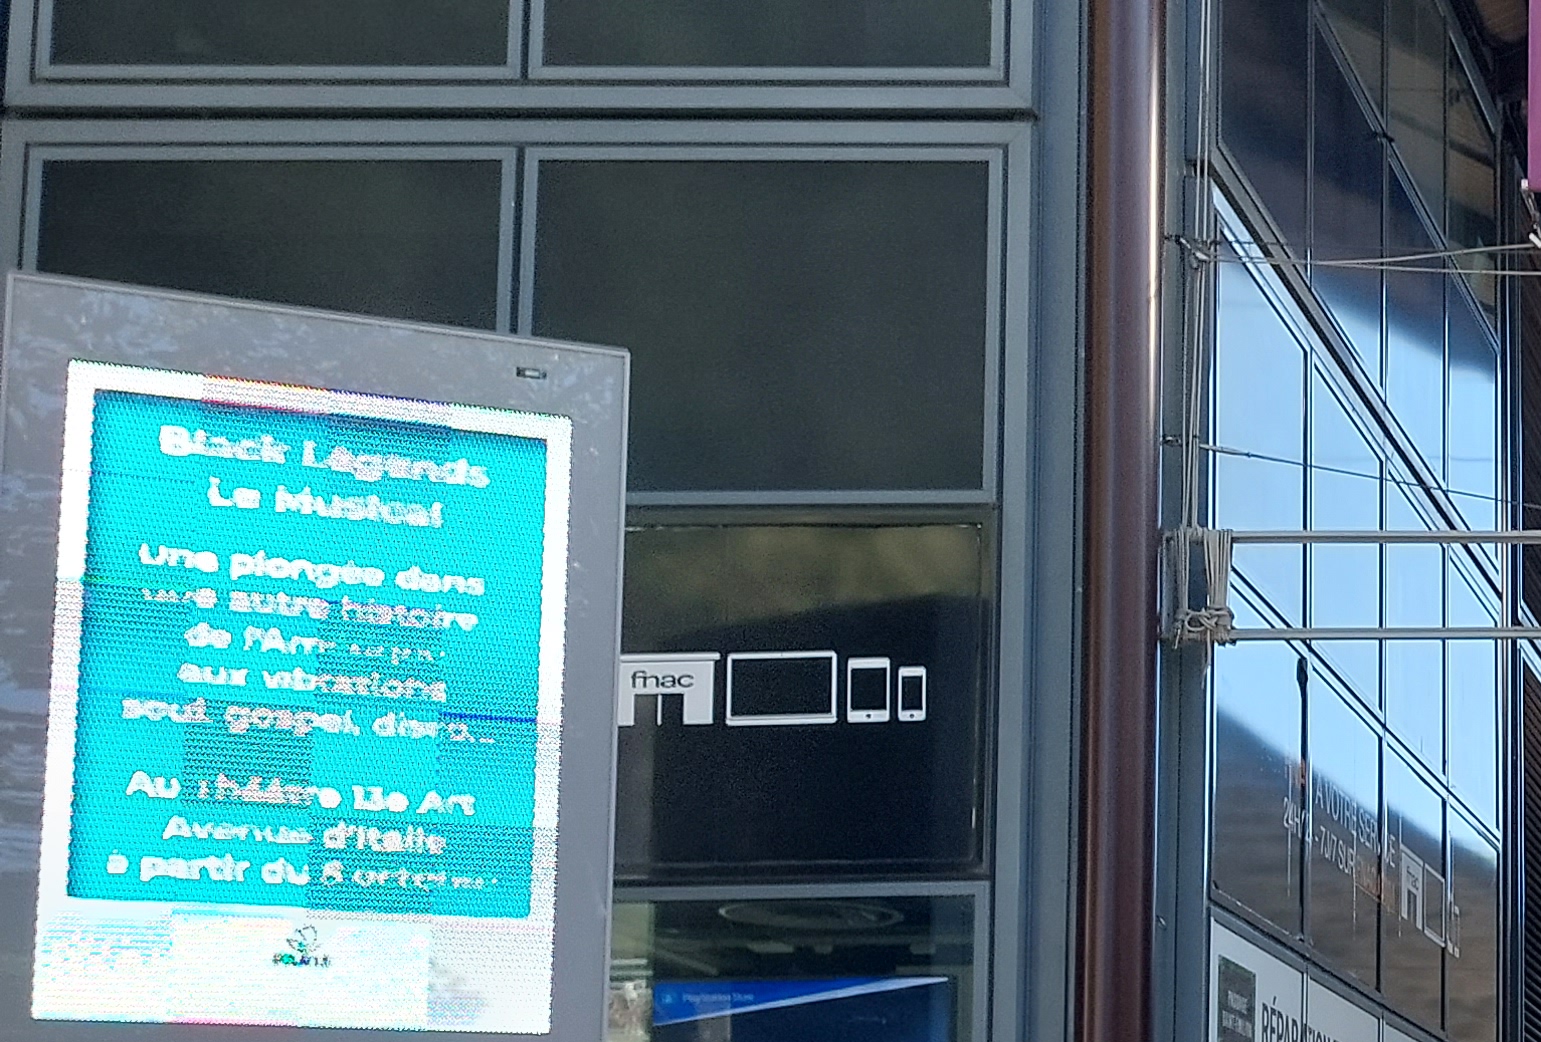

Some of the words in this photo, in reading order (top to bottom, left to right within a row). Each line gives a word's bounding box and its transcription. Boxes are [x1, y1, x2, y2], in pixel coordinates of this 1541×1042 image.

[208, 476, 260, 508] Le
[275, 485, 442, 528] Musical
[139, 543, 219, 572] Une
[395, 565, 485, 596] dans
[183, 621, 231, 648] de
[177, 663, 249, 686] aux
[630, 670, 695, 690] fnac
[126, 770, 181, 798] Au
[416, 790, 476, 815] Art
[163, 815, 314, 844] Avenue
[140, 853, 251, 882] partir
[261, 857, 310, 885] du
